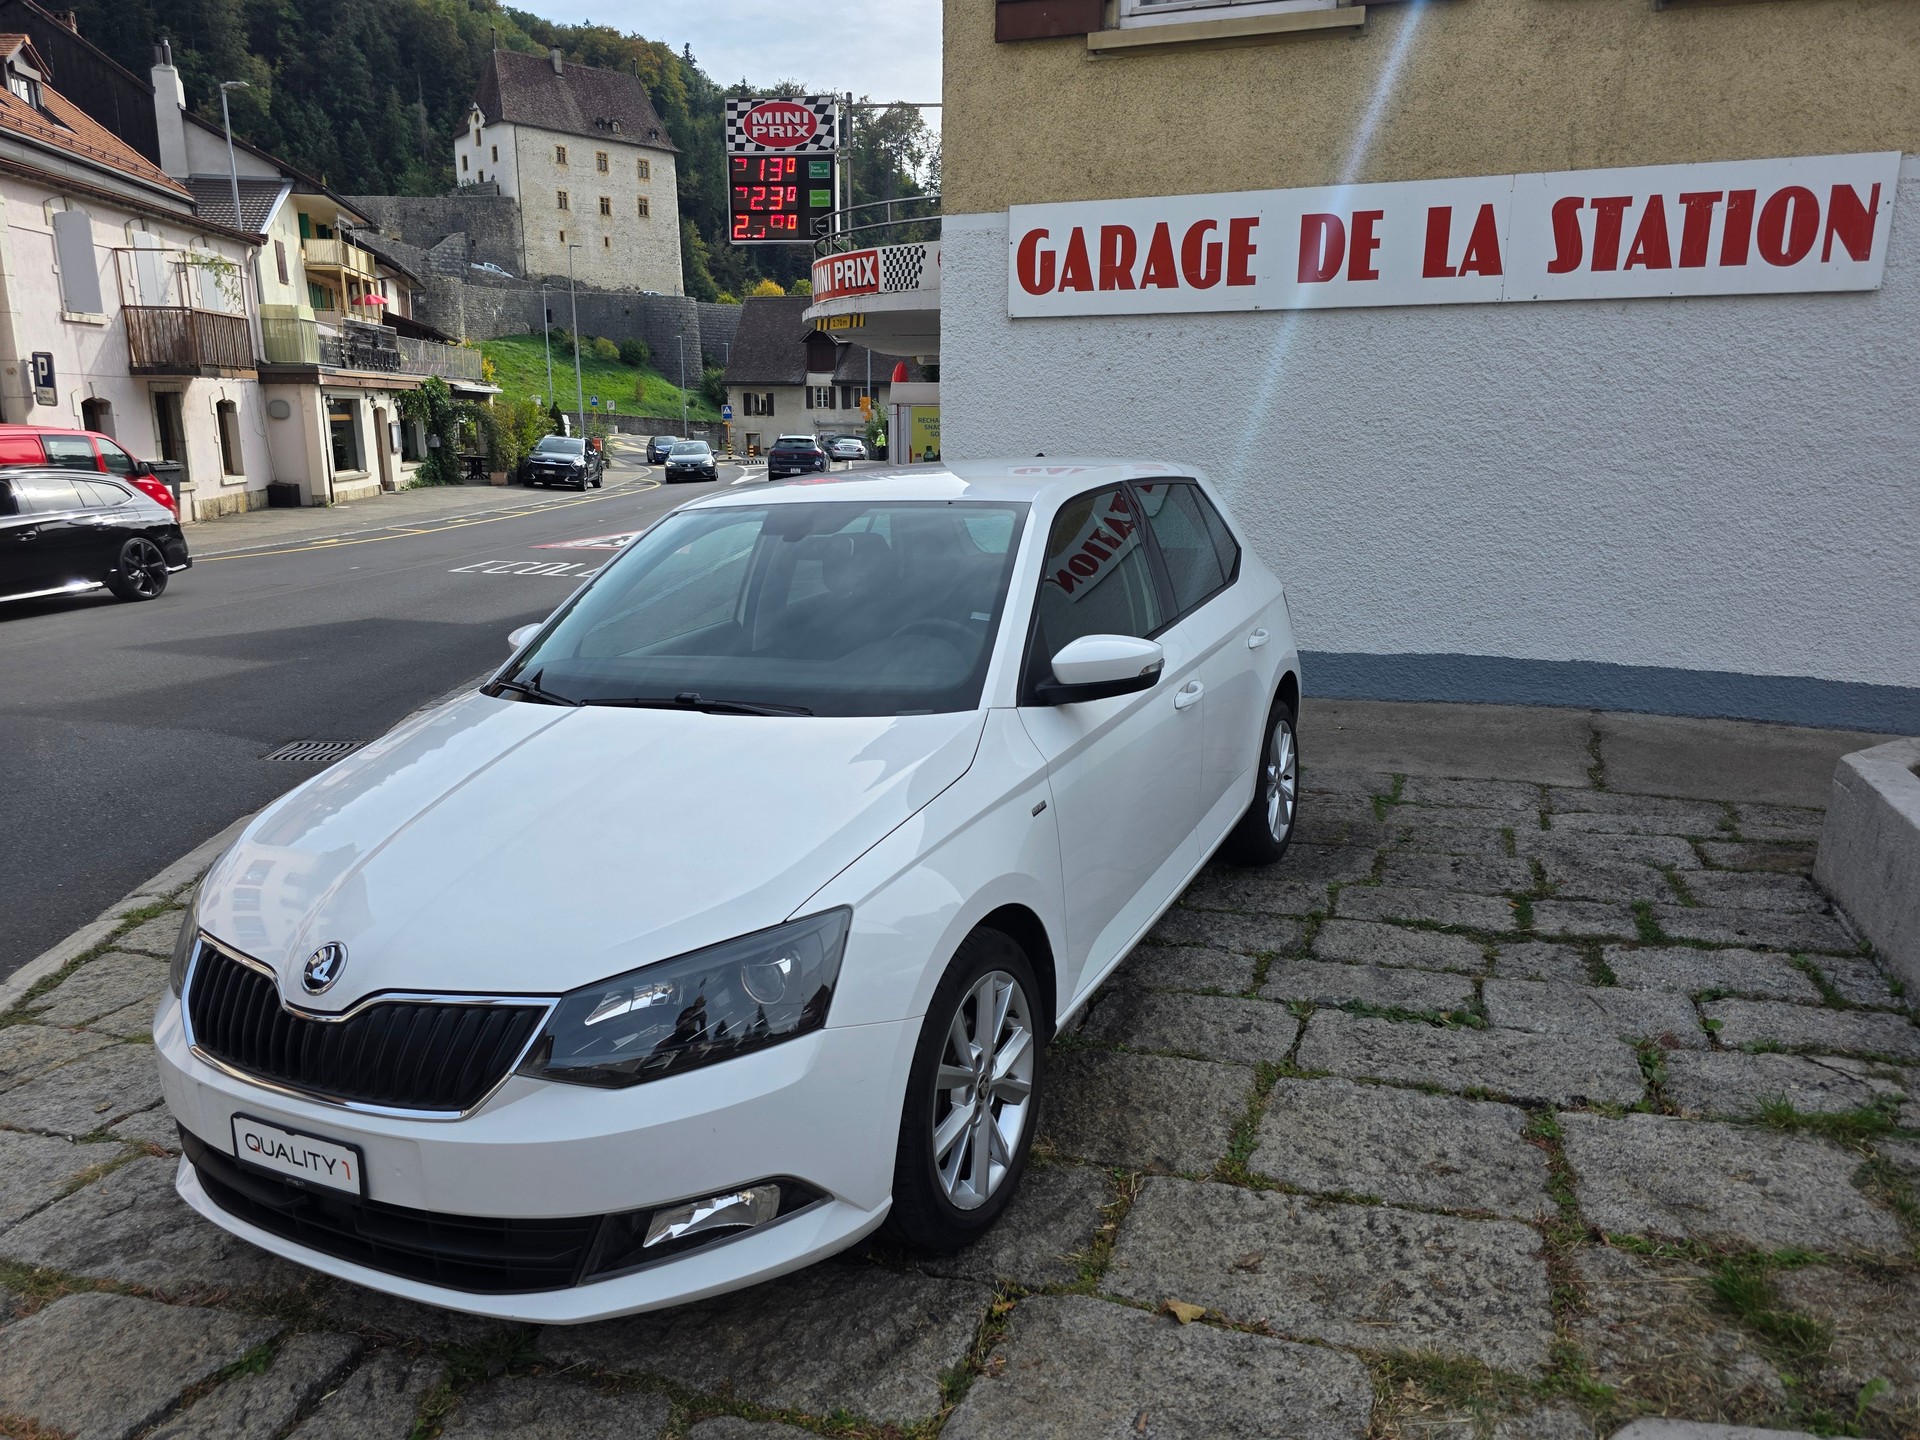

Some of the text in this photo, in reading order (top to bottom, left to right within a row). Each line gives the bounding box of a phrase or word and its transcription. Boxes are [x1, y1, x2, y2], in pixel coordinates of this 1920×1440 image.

[752, 112, 809, 124] MINI
[752, 125, 810, 138] PRIX
[1017, 183, 1882, 296] GARAGE DE LA STATION
[813, 255, 876, 296] MINI PRIX
[37, 356, 49, 385] P
[245, 1132, 351, 1180] QUALITY 1
